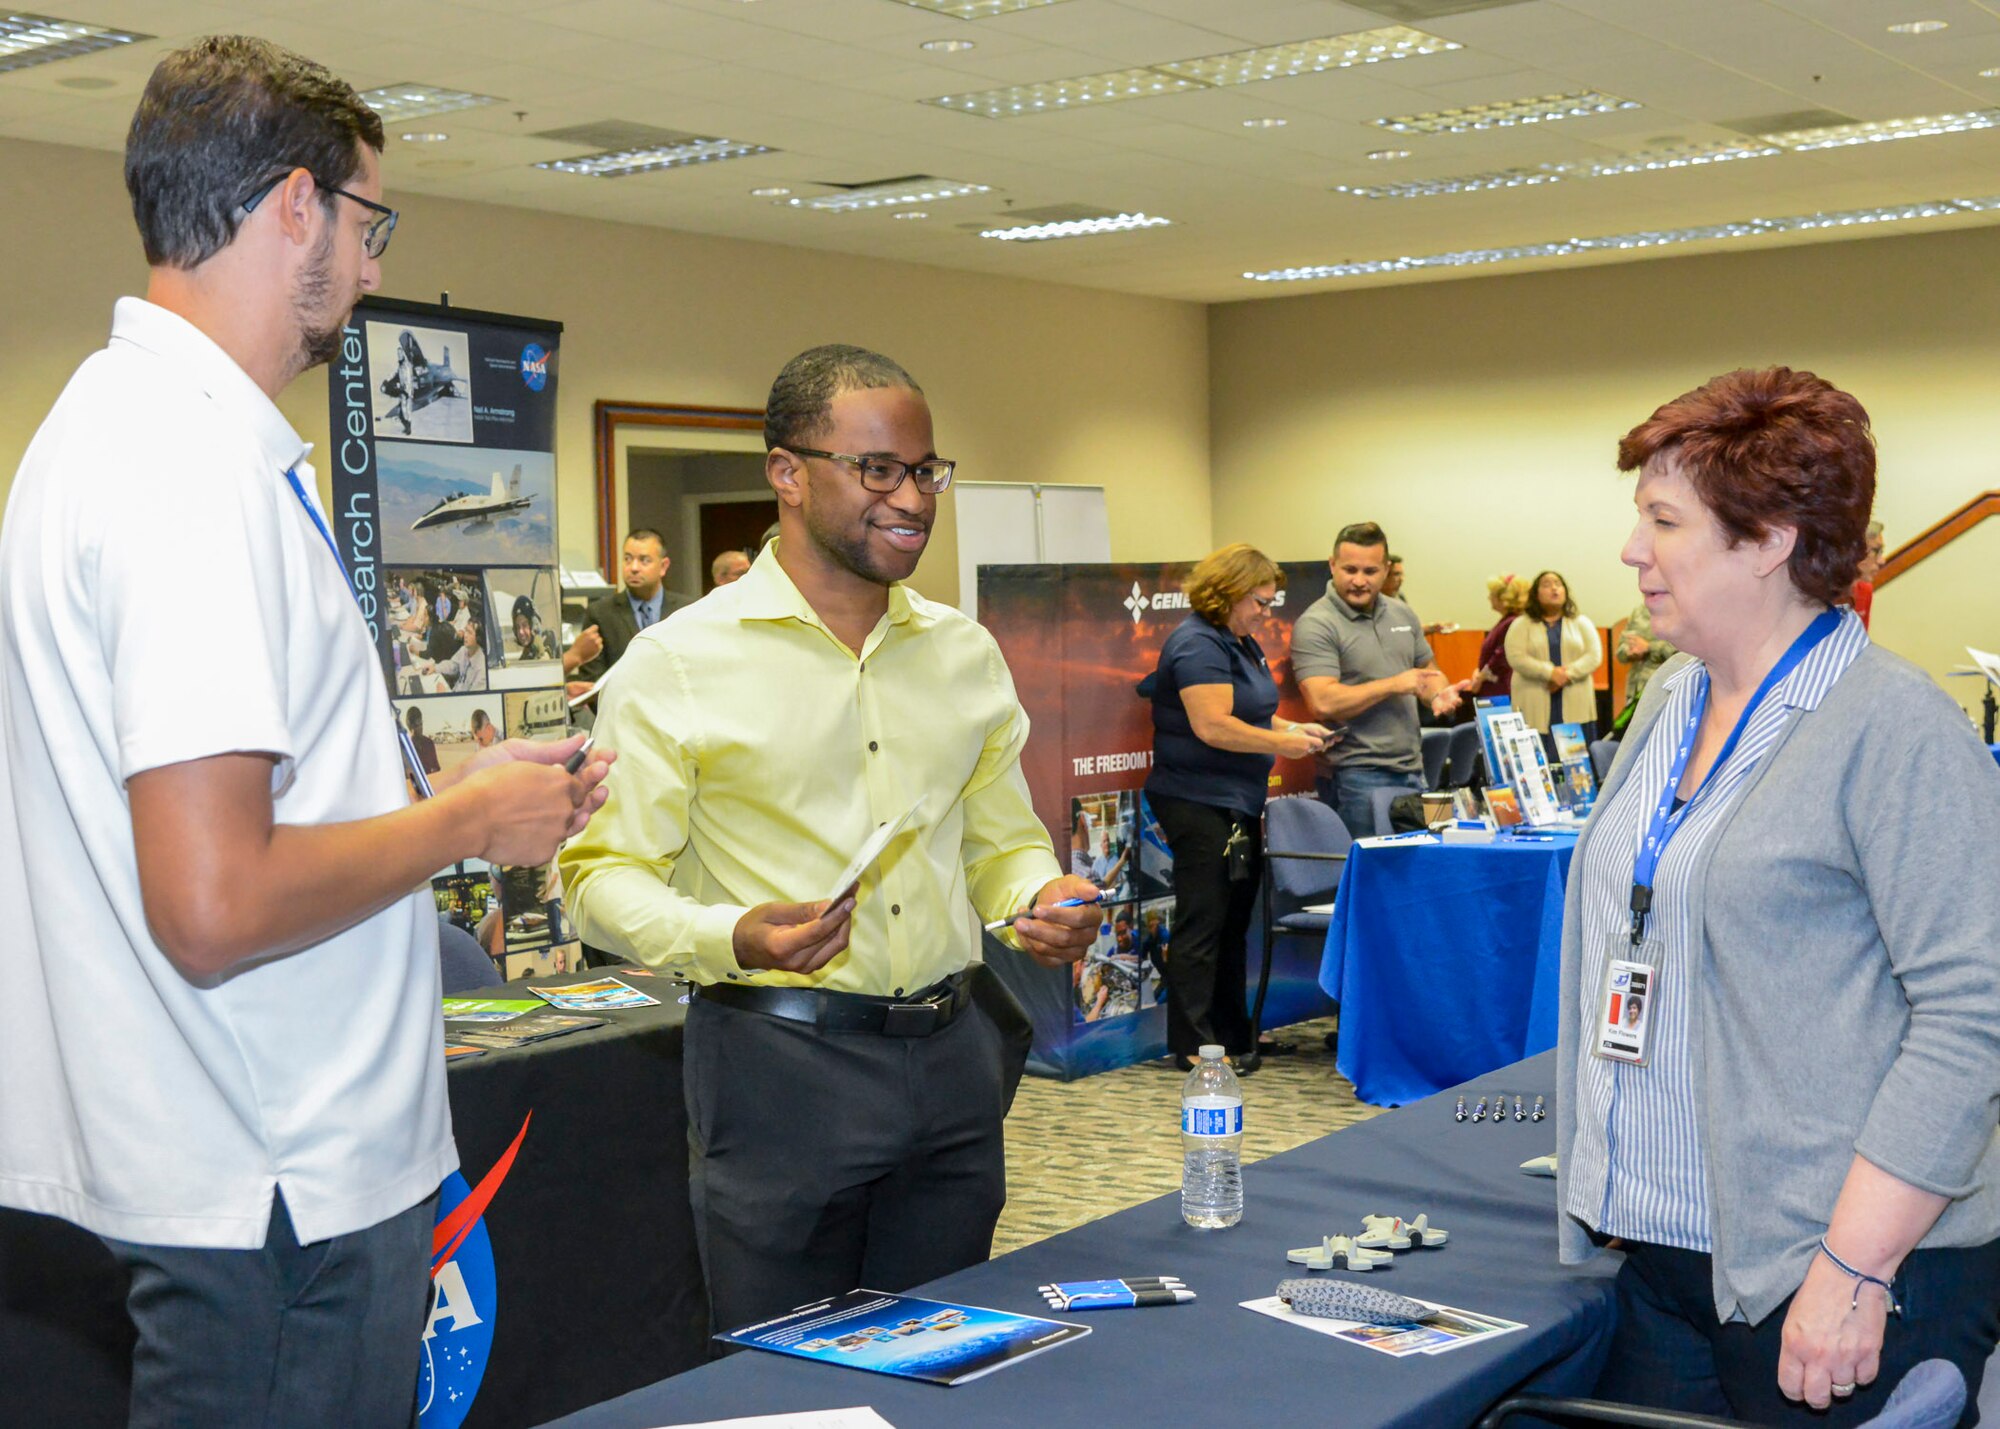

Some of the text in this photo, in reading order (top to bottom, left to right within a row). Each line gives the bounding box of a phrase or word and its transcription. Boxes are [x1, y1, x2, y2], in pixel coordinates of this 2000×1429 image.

[522, 360, 547, 375] NASA
[340, 325, 369, 475] Center
[1072, 757, 1095, 776] THE
[1096, 751, 1147, 774] FREEDOM
